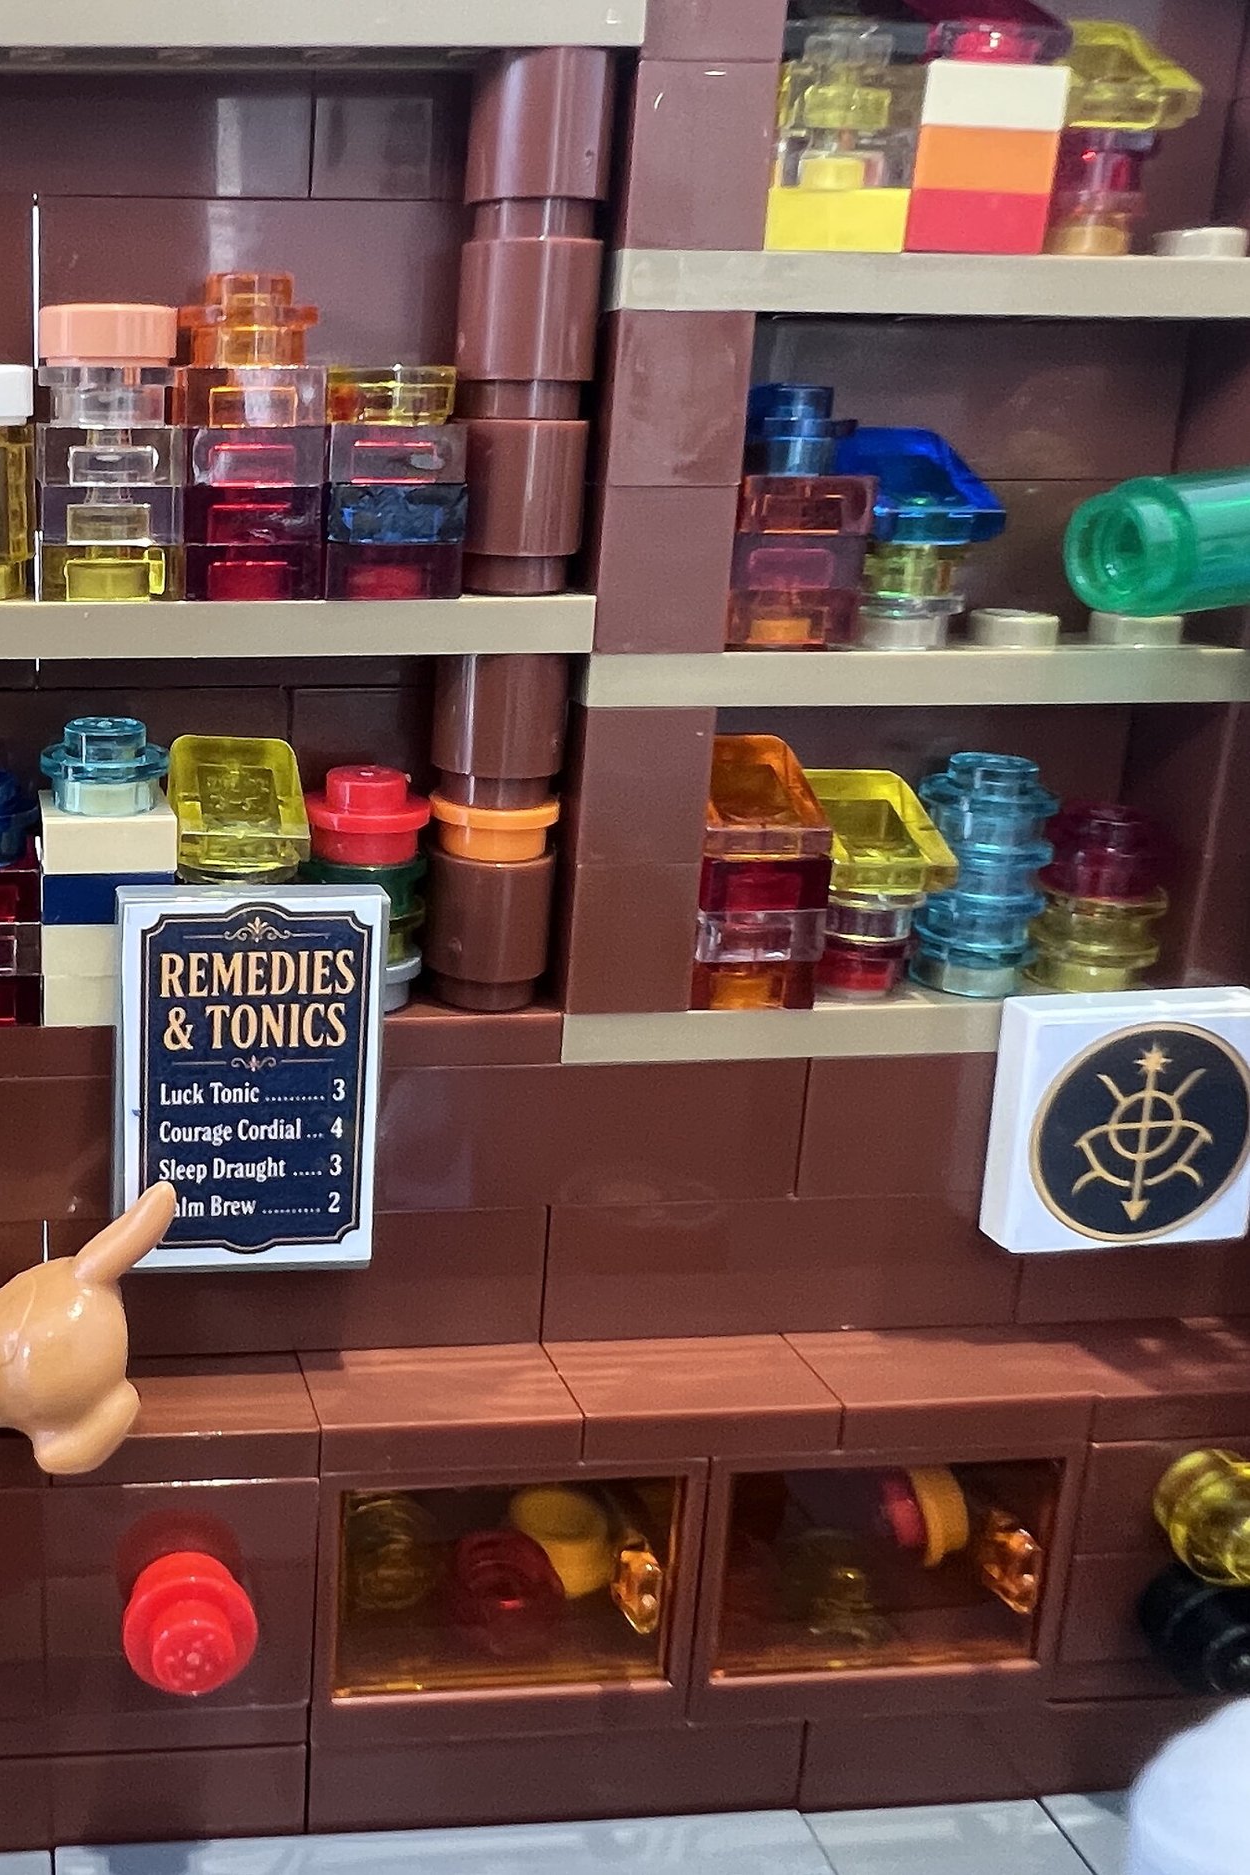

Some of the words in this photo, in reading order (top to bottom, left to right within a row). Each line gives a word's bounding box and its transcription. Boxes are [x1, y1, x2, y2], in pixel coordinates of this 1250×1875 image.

[159, 950, 356, 997] REMEDIES
[163, 1006, 194, 1051] &
[205, 1003, 347, 1049] TONICS
[160, 1082, 204, 1105] Luck
[209, 1081, 260, 1104] Tonic
[332, 1078, 346, 1101] 3
[159, 1120, 233, 1147] Courage
[237, 1117, 302, 1141] Cordial
[330, 1116, 343, 1139] 4
[158, 1158, 208, 1184] Sleep
[213, 1156, 287, 1183] Draught
[329, 1153, 343, 1176] 3
[174, 1196, 204, 1217] alm
[210, 1195, 257, 1217] Brew
[327, 1191, 341, 1214] 2
